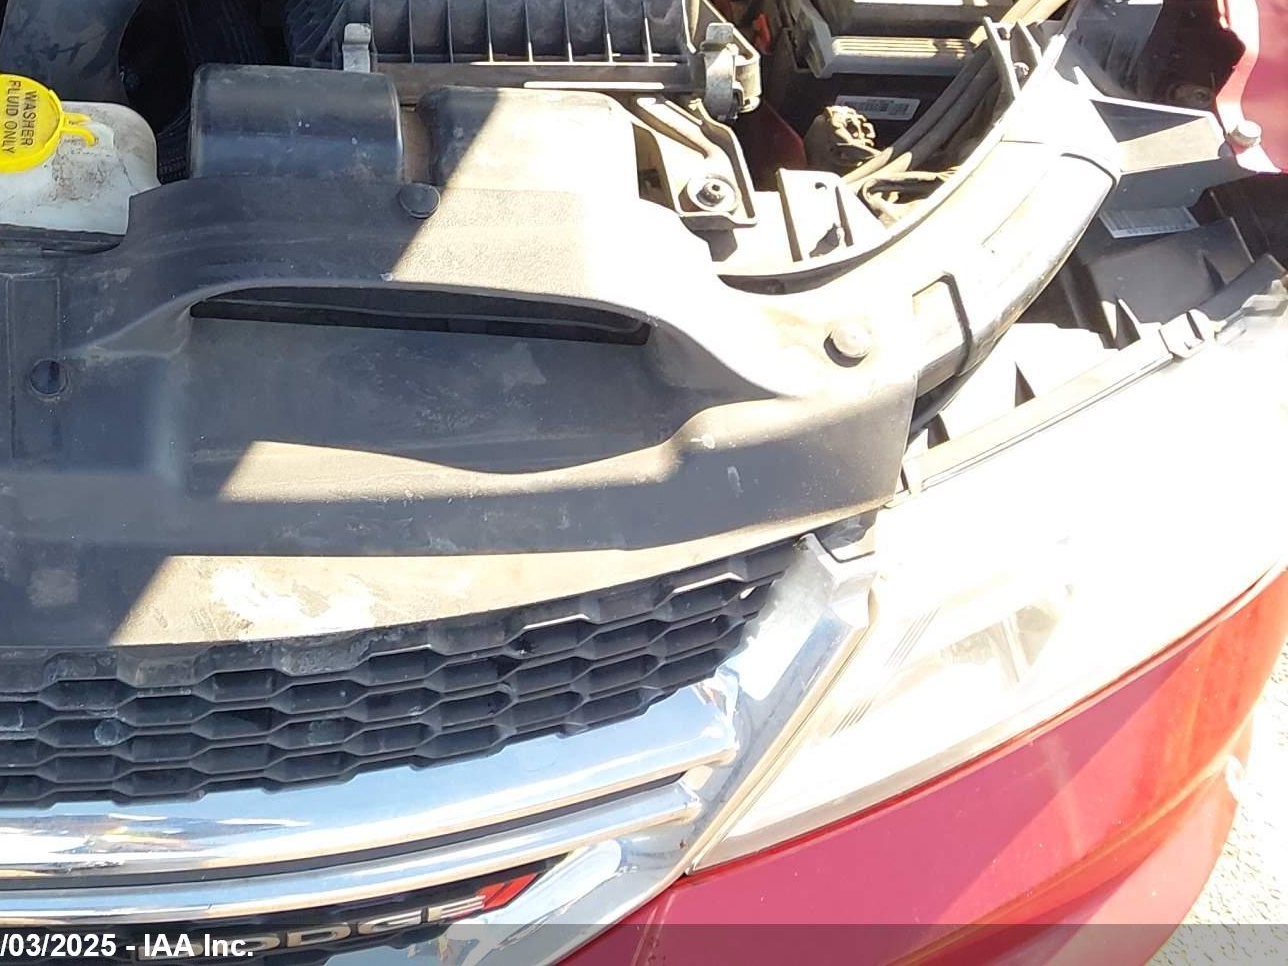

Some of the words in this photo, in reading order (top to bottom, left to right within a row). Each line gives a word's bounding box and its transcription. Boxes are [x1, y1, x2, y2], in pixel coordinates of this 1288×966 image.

[5, 79, 22, 118] FLUID
[1, 120, 18, 154] ONLY
[20, 90, 38, 147] WASHER
